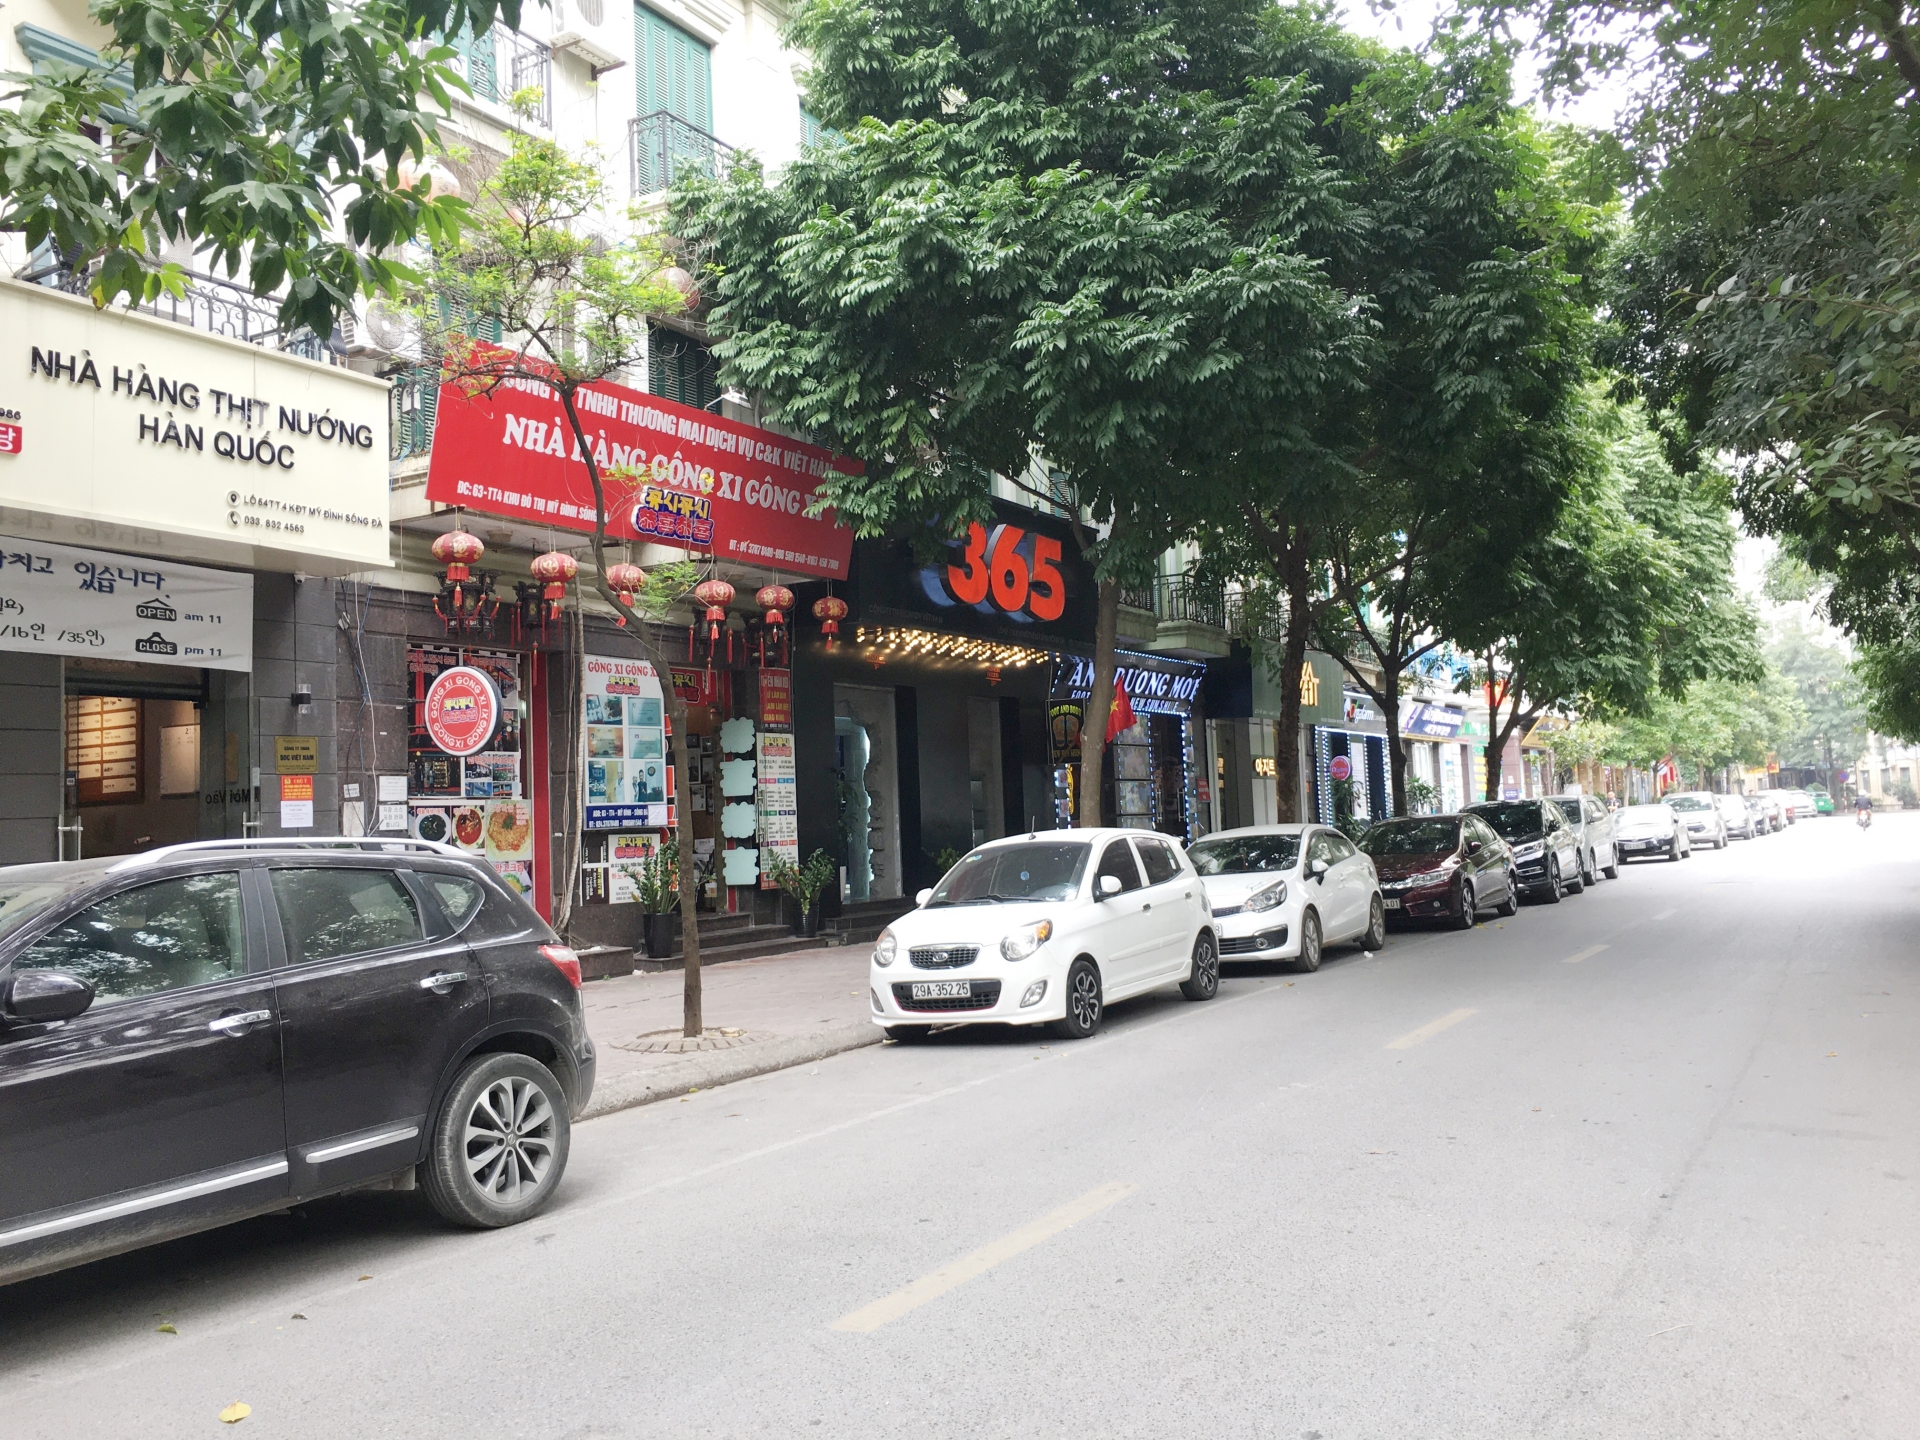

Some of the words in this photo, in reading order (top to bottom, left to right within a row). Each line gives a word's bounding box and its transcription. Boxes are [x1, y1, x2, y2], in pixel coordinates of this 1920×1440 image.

[30, 346, 102, 388] NHÀ
[112, 363, 200, 409] HÀNG
[209, 389, 270, 429] THỊT
[278, 406, 374, 449] NƯỚNG
[138, 411, 203, 451] HÀN
[213, 431, 295, 469] QUỐC
[577, 387, 618, 418] TNHH
[621, 400, 677, 436] THƯƠNG
[678, 418, 705, 446] MẠI
[706, 427, 736, 453] DỊCH
[738, 436, 755, 462] VỤ
[755, 442, 782, 466] C&K
[784, 450, 808, 475] VIỆT
[503, 413, 566, 458] NHÀ
[651, 451, 715, 494] GÔNG
[717, 472, 743, 502] XI
[745, 475, 800, 515] GÔNG
[289, 503, 307, 514] KĐT
[323, 508, 343, 521] ĐÌNH
[457, 480, 472, 496] ĐC:
[503, 491, 520, 506] KHU
[521, 493, 532, 509] ĐÔ
[533, 497, 546, 515] THỊ
[547, 499, 559, 514] MỸ
[560, 502, 578, 518] ĐÌNH
[265, 519, 281, 529] 832
[284, 523, 305, 533] 4563
[946, 517, 1066, 622] 365
[138, 607, 176, 620] OPEN
[184, 613, 204, 622] am
[209, 615, 222, 624] 11
[139, 642, 174, 653] CLOSE
[184, 645, 204, 655] pm
[209, 648, 222, 656] 11
[588, 659, 612, 674] GÔNG
[614, 664, 623, 674] XI
[626, 662, 648, 676] GÔNG
[1068, 662, 1095, 688] AN
[431, 687, 444, 718] GONG
[444, 679, 453, 689] XI
[456, 676, 481, 693] GONG
[479, 694, 487, 705] XI
[1060, 705, 1069, 714] AND
[1130, 697, 1145, 709] NEW
[434, 723, 454, 746] GONG
[455, 740, 464, 748] XI
[467, 721, 486, 745] GONG
[482, 709, 488, 719] XI
[914, 983, 968, 997] 29A-352.25
